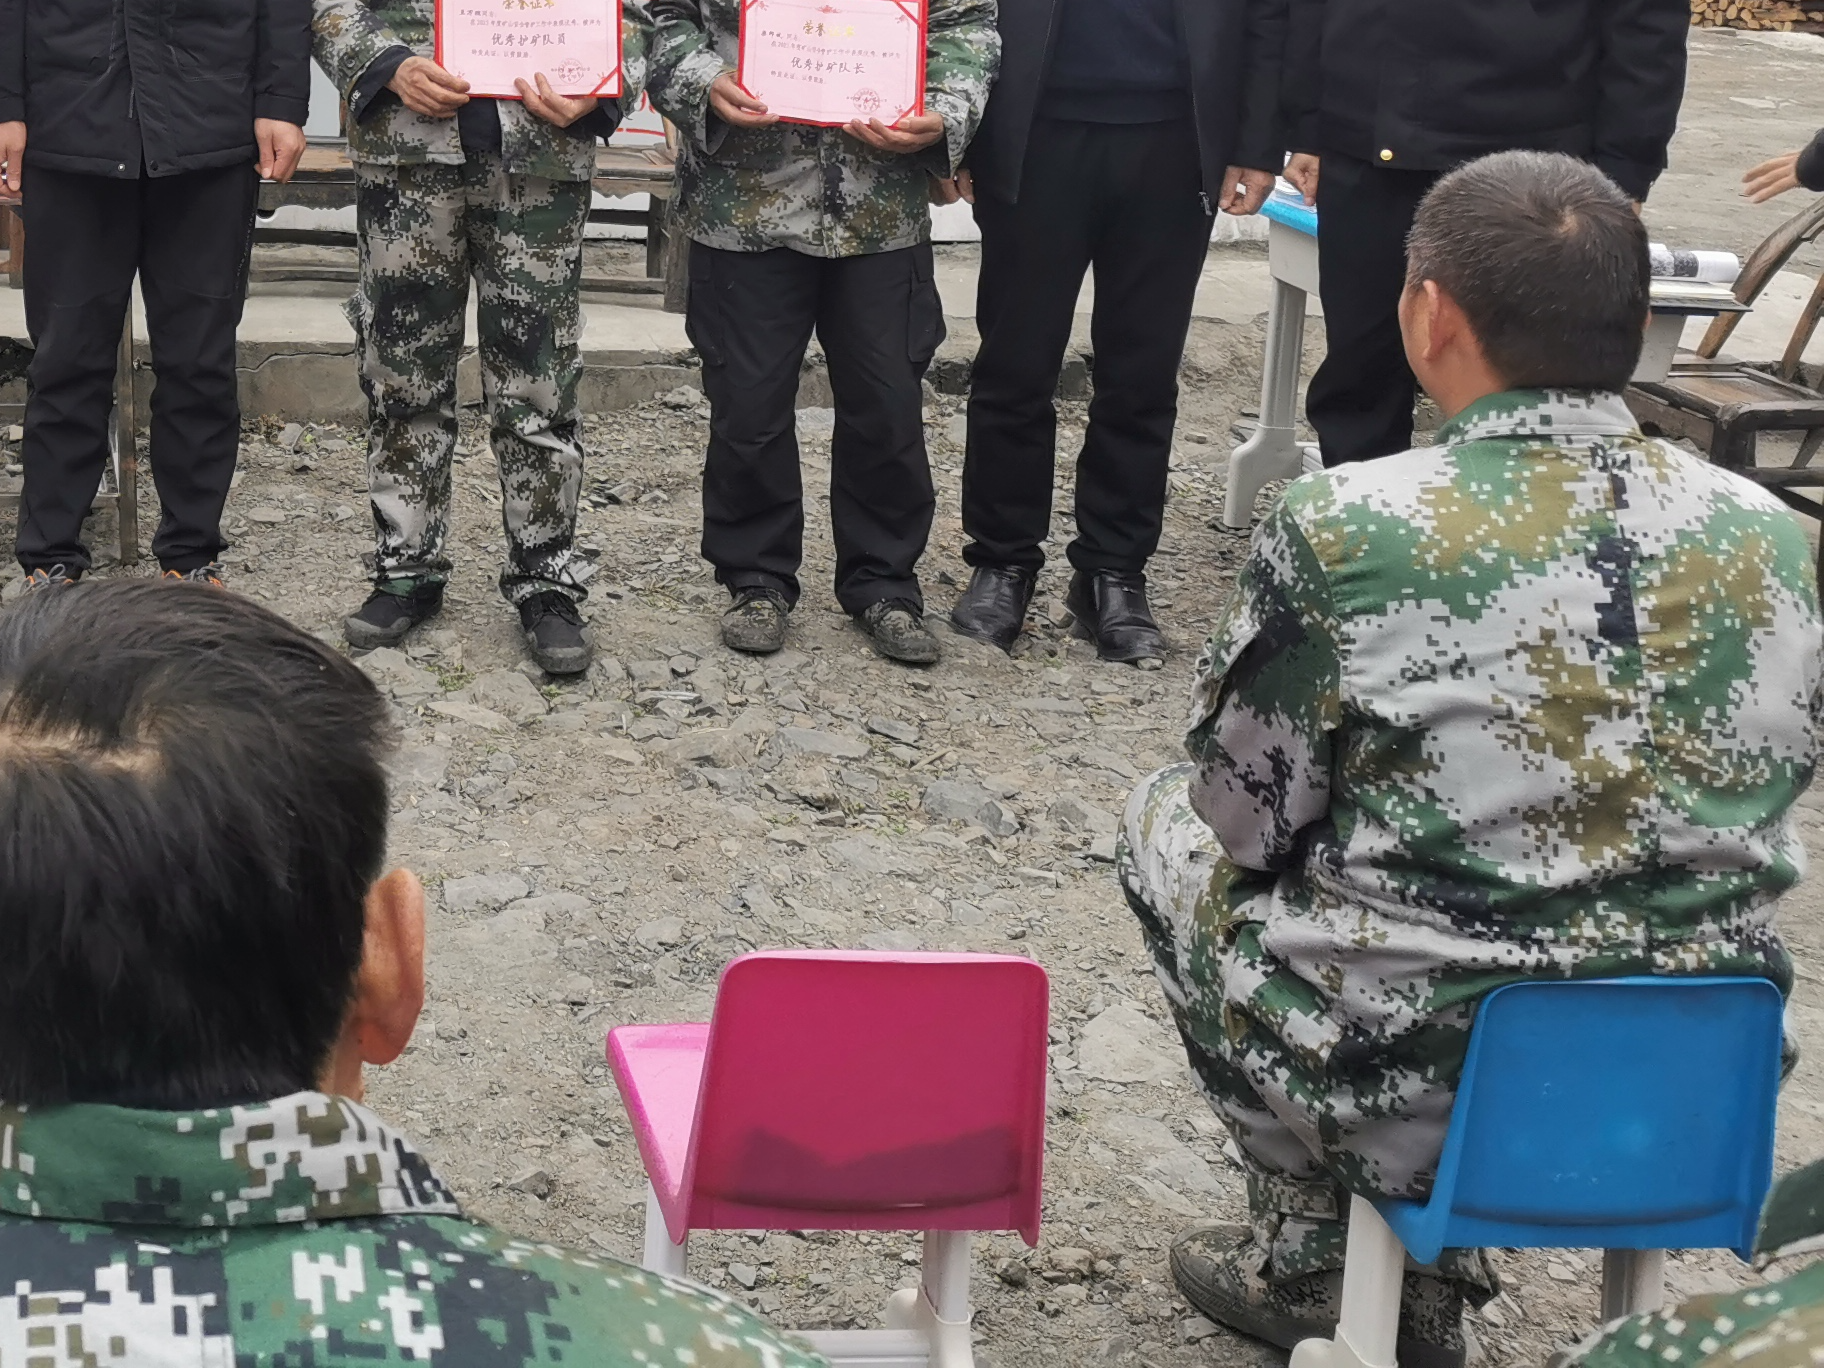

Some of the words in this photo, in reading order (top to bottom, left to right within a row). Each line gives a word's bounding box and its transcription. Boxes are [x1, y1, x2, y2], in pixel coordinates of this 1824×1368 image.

[491, 32, 566, 47] 优秀护矿队员
